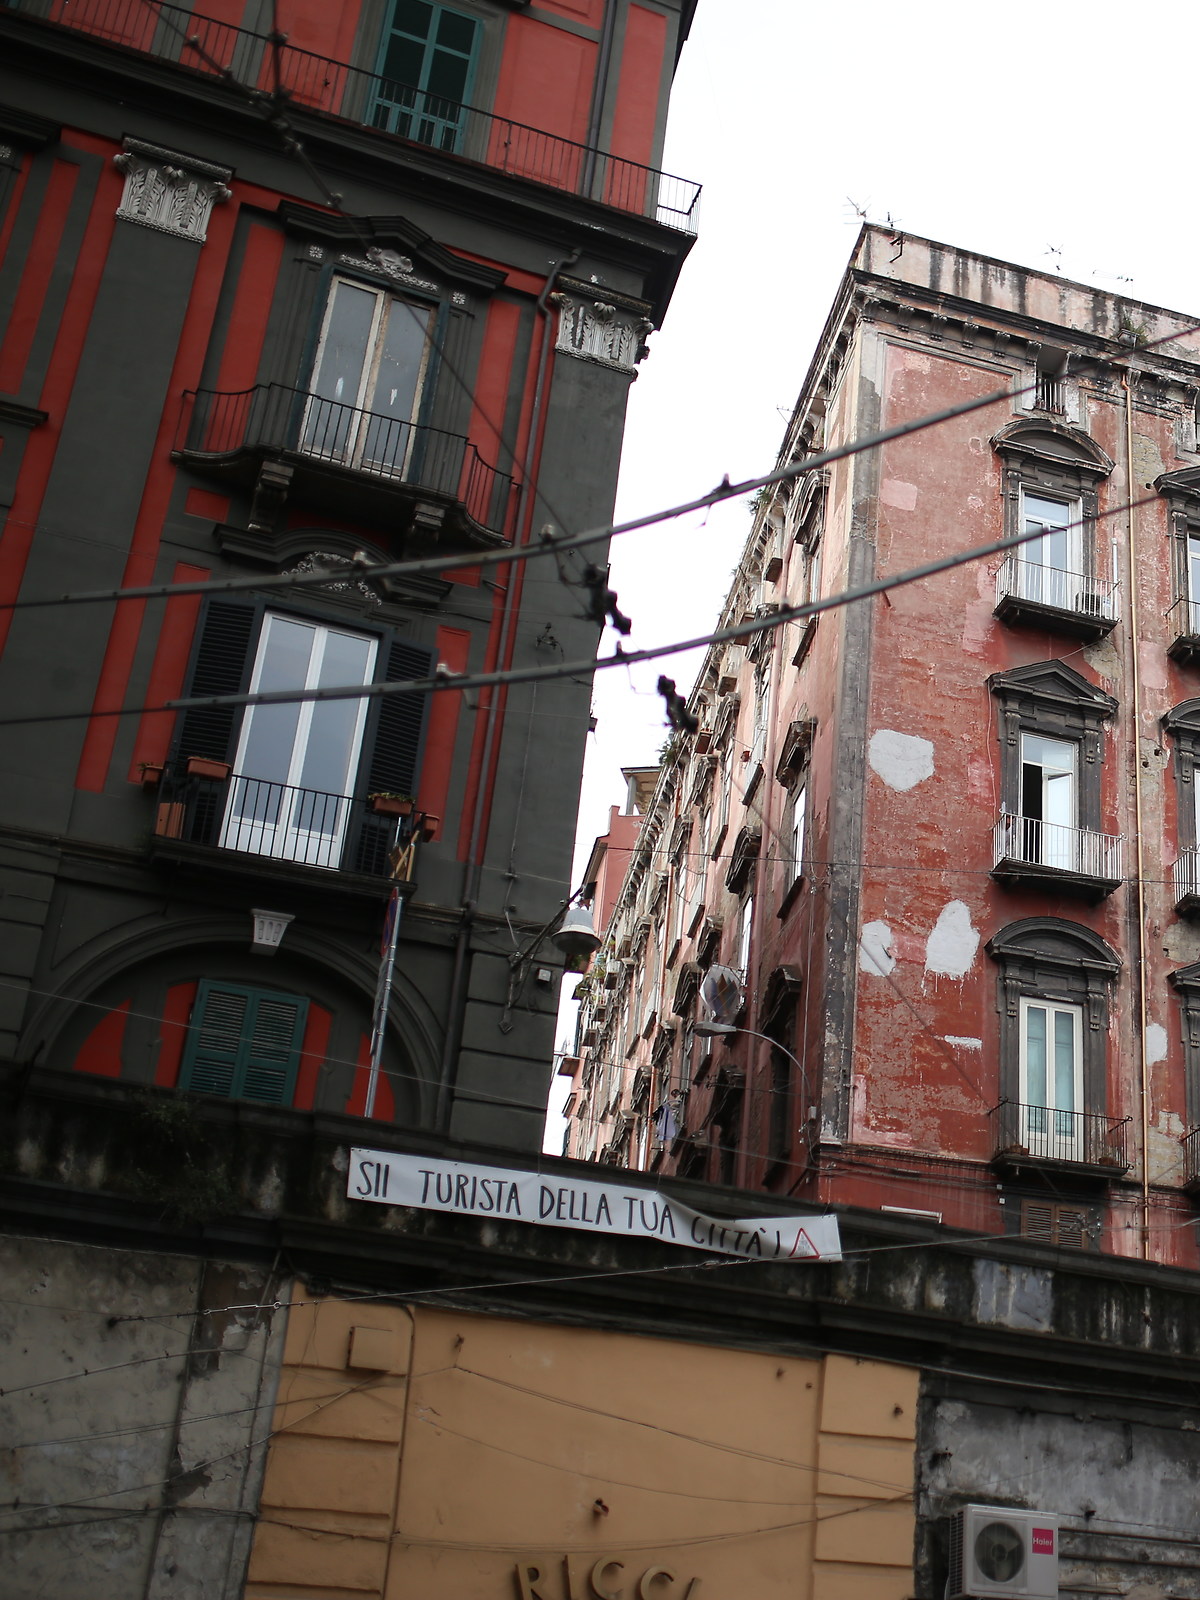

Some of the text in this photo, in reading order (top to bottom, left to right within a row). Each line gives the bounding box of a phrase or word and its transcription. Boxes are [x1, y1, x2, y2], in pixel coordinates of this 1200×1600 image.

[356, 1160, 390, 1198] SII
[418, 1169, 521, 1216] TURISTA
[538, 1185, 612, 1226] DELLA
[623, 1196, 676, 1239] TUA
[1031, 1537, 1053, 1546] Haier
